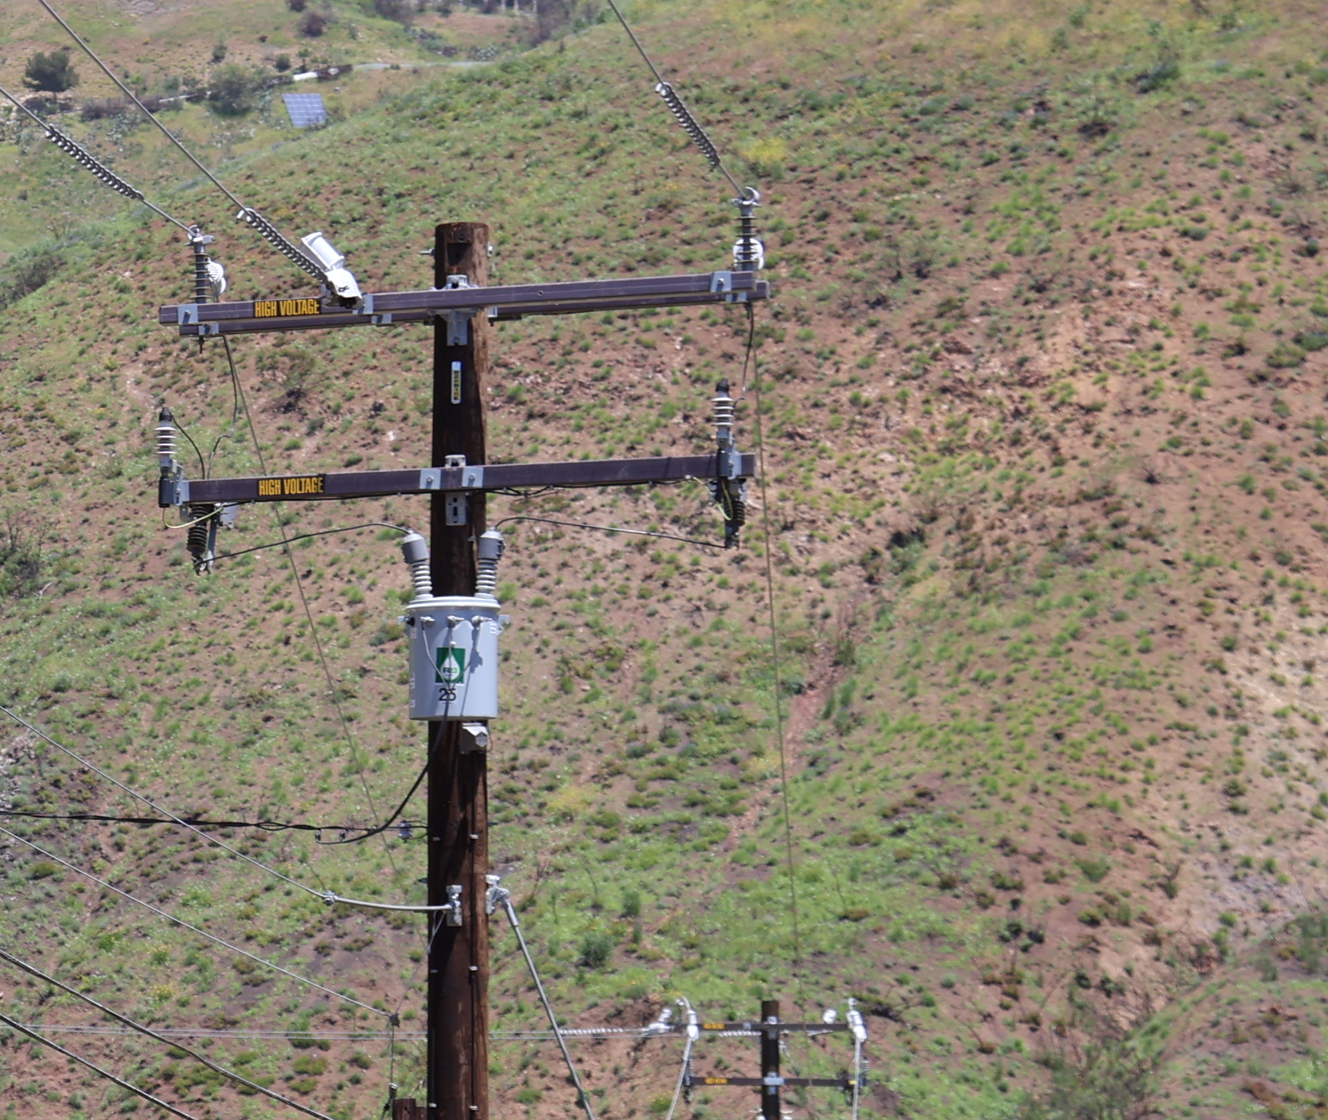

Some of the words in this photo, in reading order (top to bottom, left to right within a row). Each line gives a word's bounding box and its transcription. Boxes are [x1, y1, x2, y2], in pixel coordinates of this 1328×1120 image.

[254, 301, 277, 317] HIGH
[279, 299, 320, 316] VOLTAGE
[259, 479, 281, 496] HIGH
[284, 477, 324, 494] VOLTAGE
